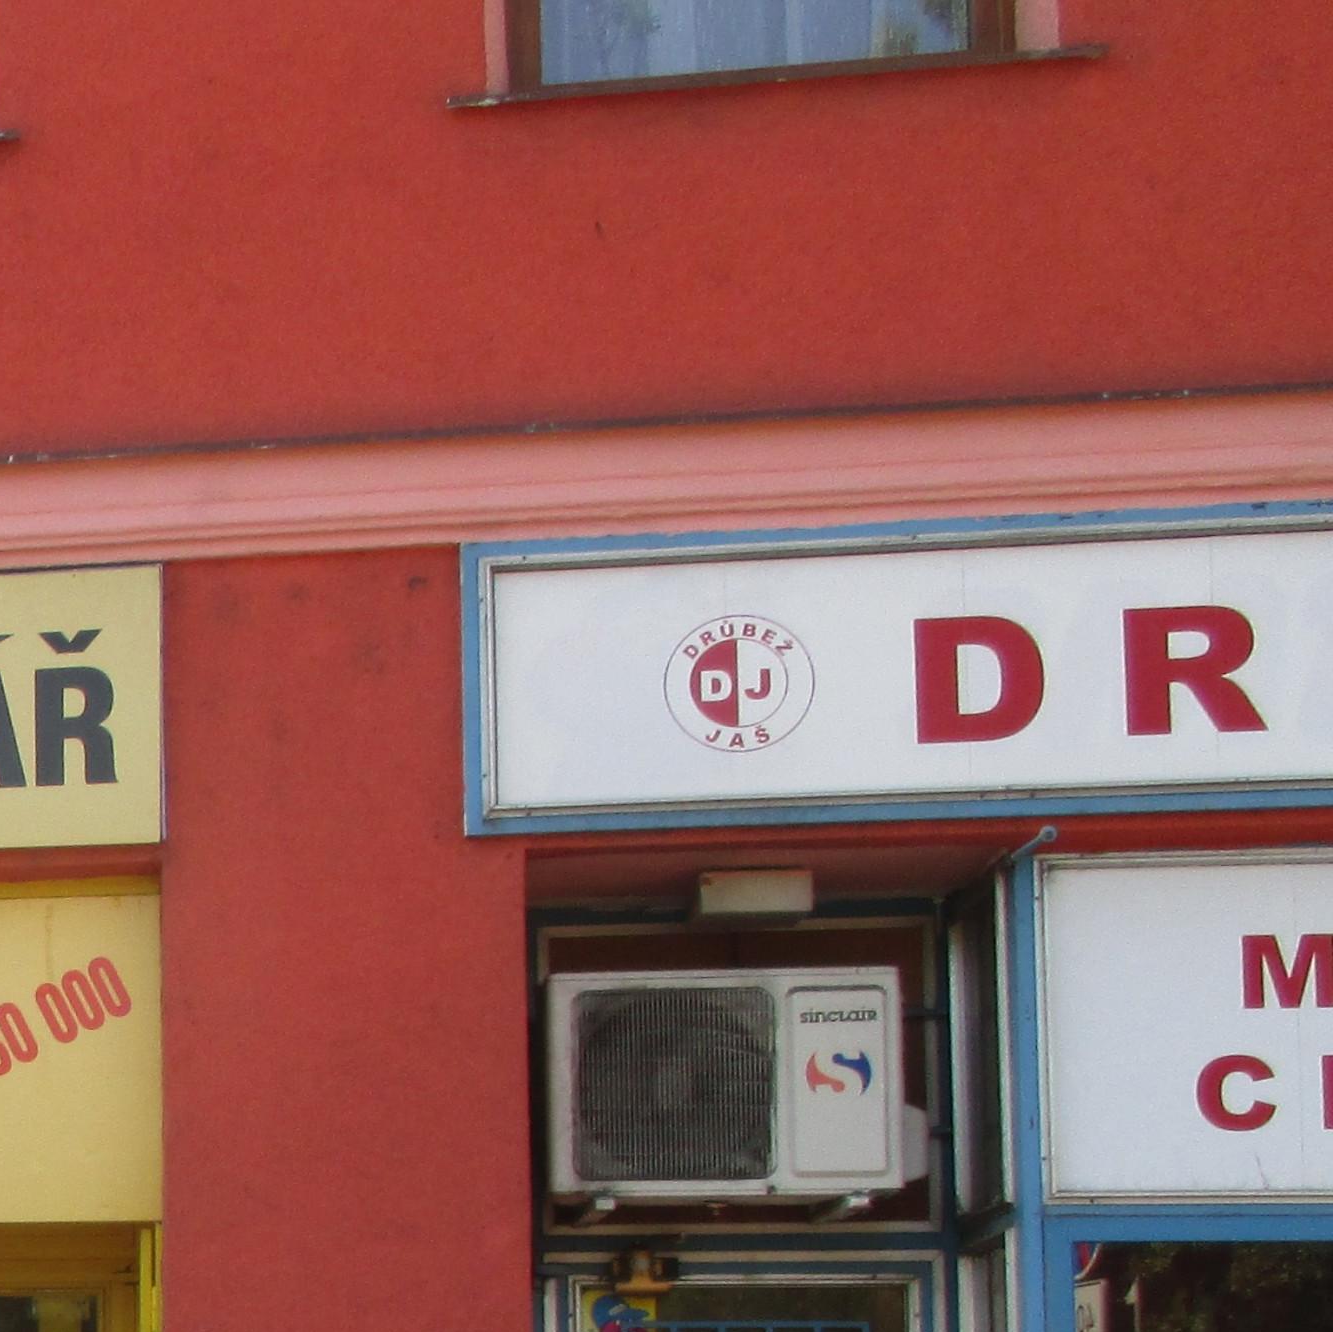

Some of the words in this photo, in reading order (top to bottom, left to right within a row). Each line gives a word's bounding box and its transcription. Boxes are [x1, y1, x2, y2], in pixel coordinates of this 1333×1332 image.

[705, 725, 770, 748] JAŠ
[34, 956, 132, 1044] 000
[1196, 1054, 1333, 1132] C
